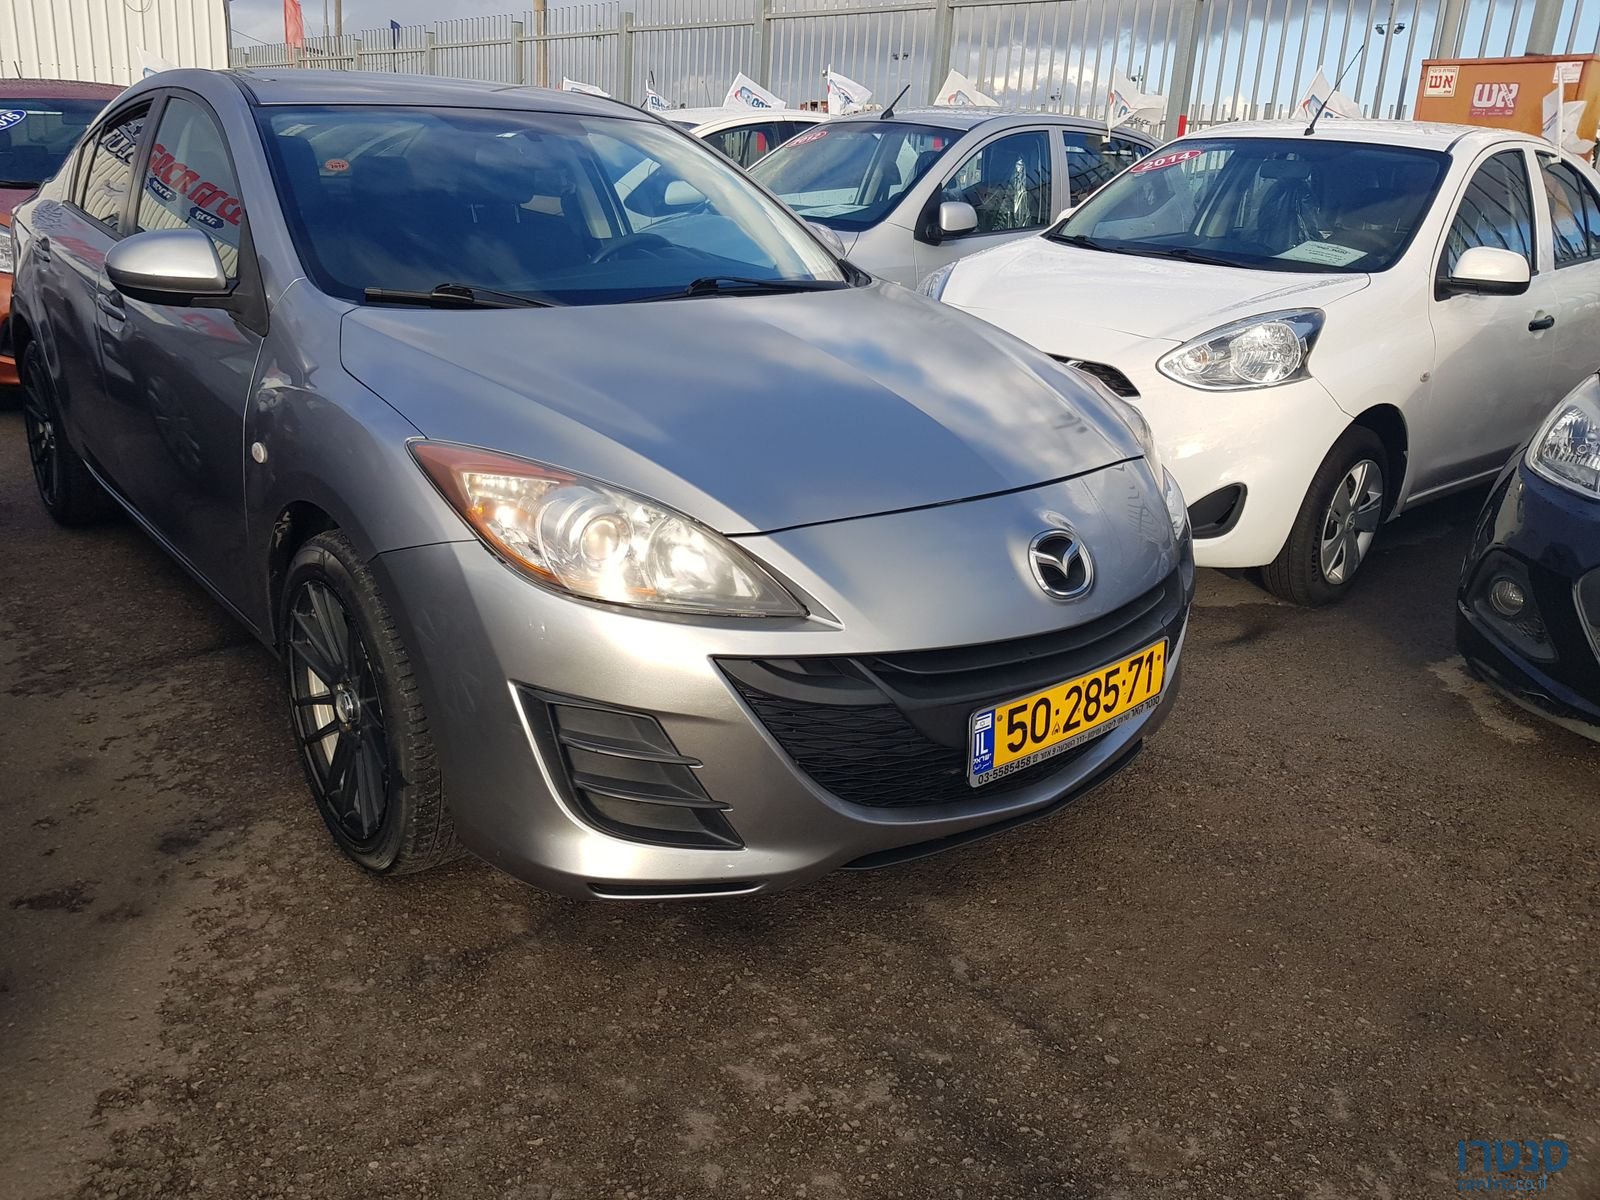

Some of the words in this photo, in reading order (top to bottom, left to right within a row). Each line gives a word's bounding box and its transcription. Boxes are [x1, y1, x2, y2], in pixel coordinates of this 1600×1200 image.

[1429, 75, 1454, 88] אש
[1473, 83, 1519, 108] אש
[0, 112, 21, 127] 015
[1142, 152, 1191, 170] 2014
[1131, 704, 1144, 717] קאר
[1145, 696, 1160, 709] סנטר
[976, 732, 989, 756] IL
[978, 756, 1031, 784] 03-5585458
